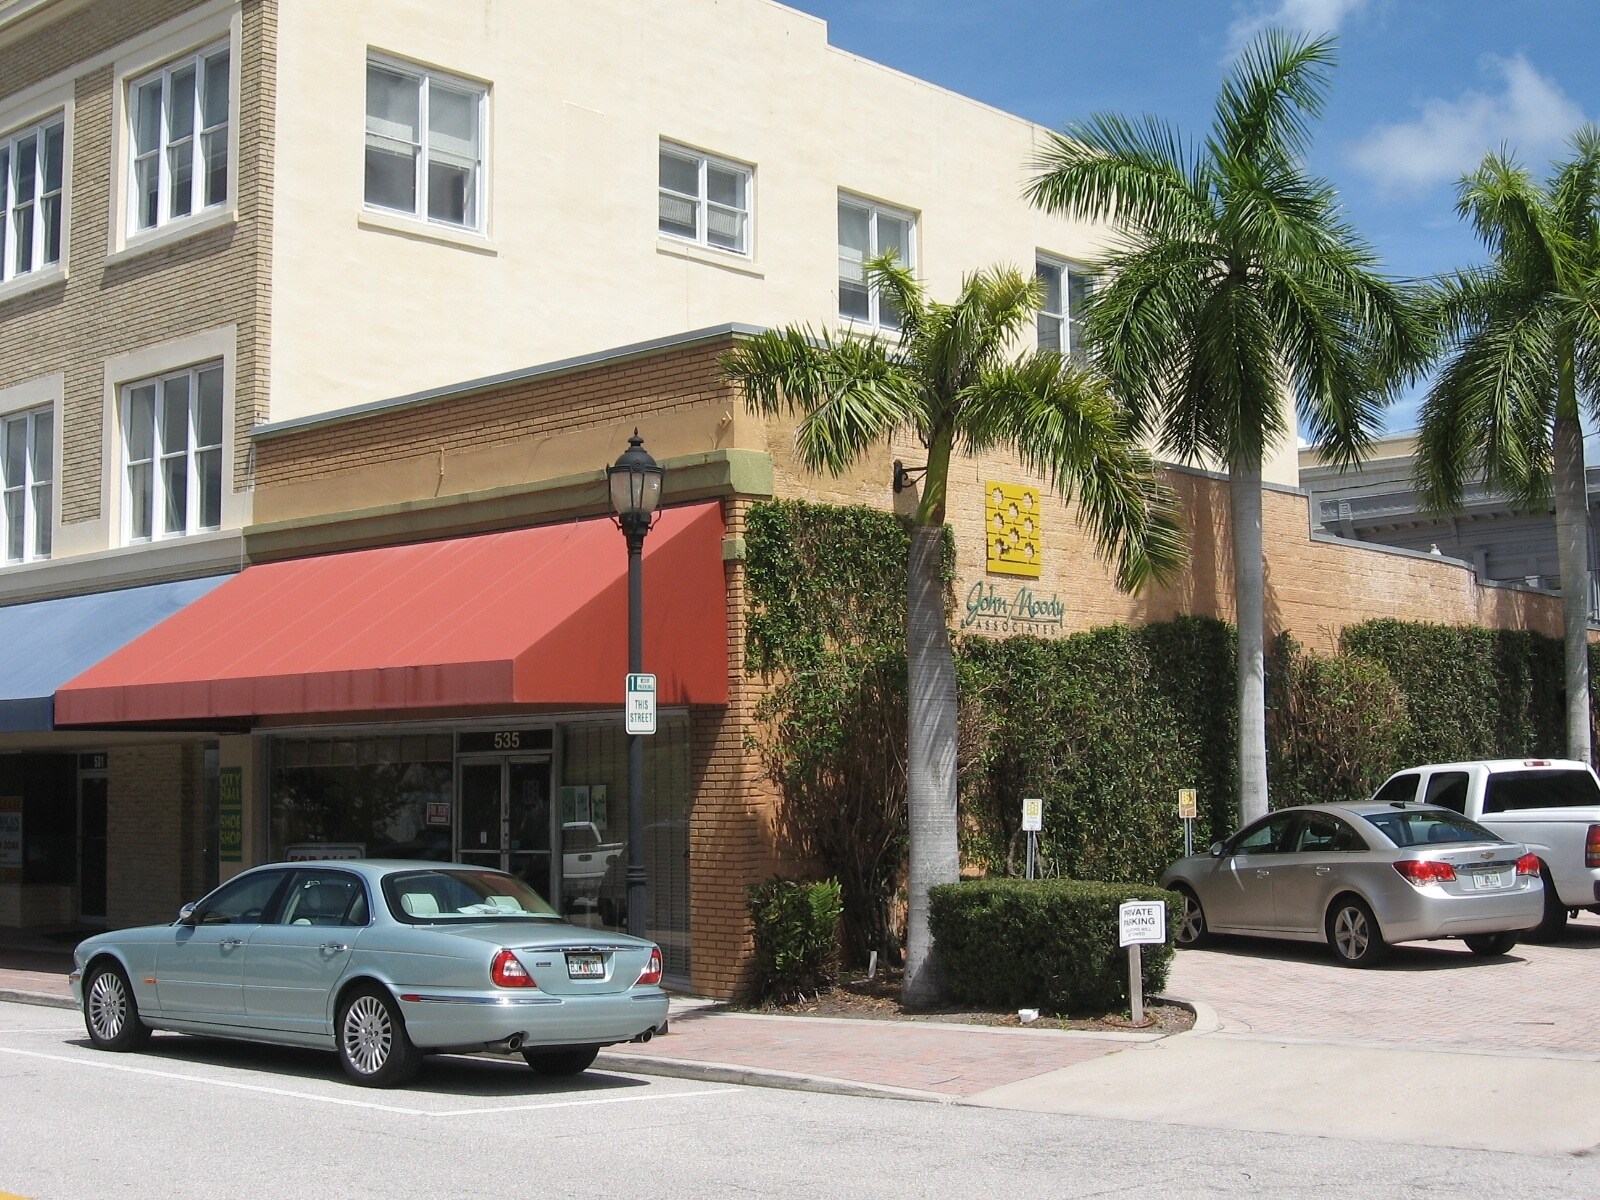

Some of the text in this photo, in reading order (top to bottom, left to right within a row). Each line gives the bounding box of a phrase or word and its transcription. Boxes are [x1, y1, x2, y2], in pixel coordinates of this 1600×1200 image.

[966, 581, 1065, 629] John Moody
[976, 620, 1056, 635] ASSOCIATES
[630, 676, 635, 691] 1
[635, 700, 648, 709] THIS
[630, 713, 652, 722] STREET
[494, 731, 520, 749] 535
[220, 772, 241, 786] CITY
[220, 831, 241, 845] SHOP
[1124, 908, 1154, 917] PRIVATE
[1124, 917, 1155, 928] PARKING
